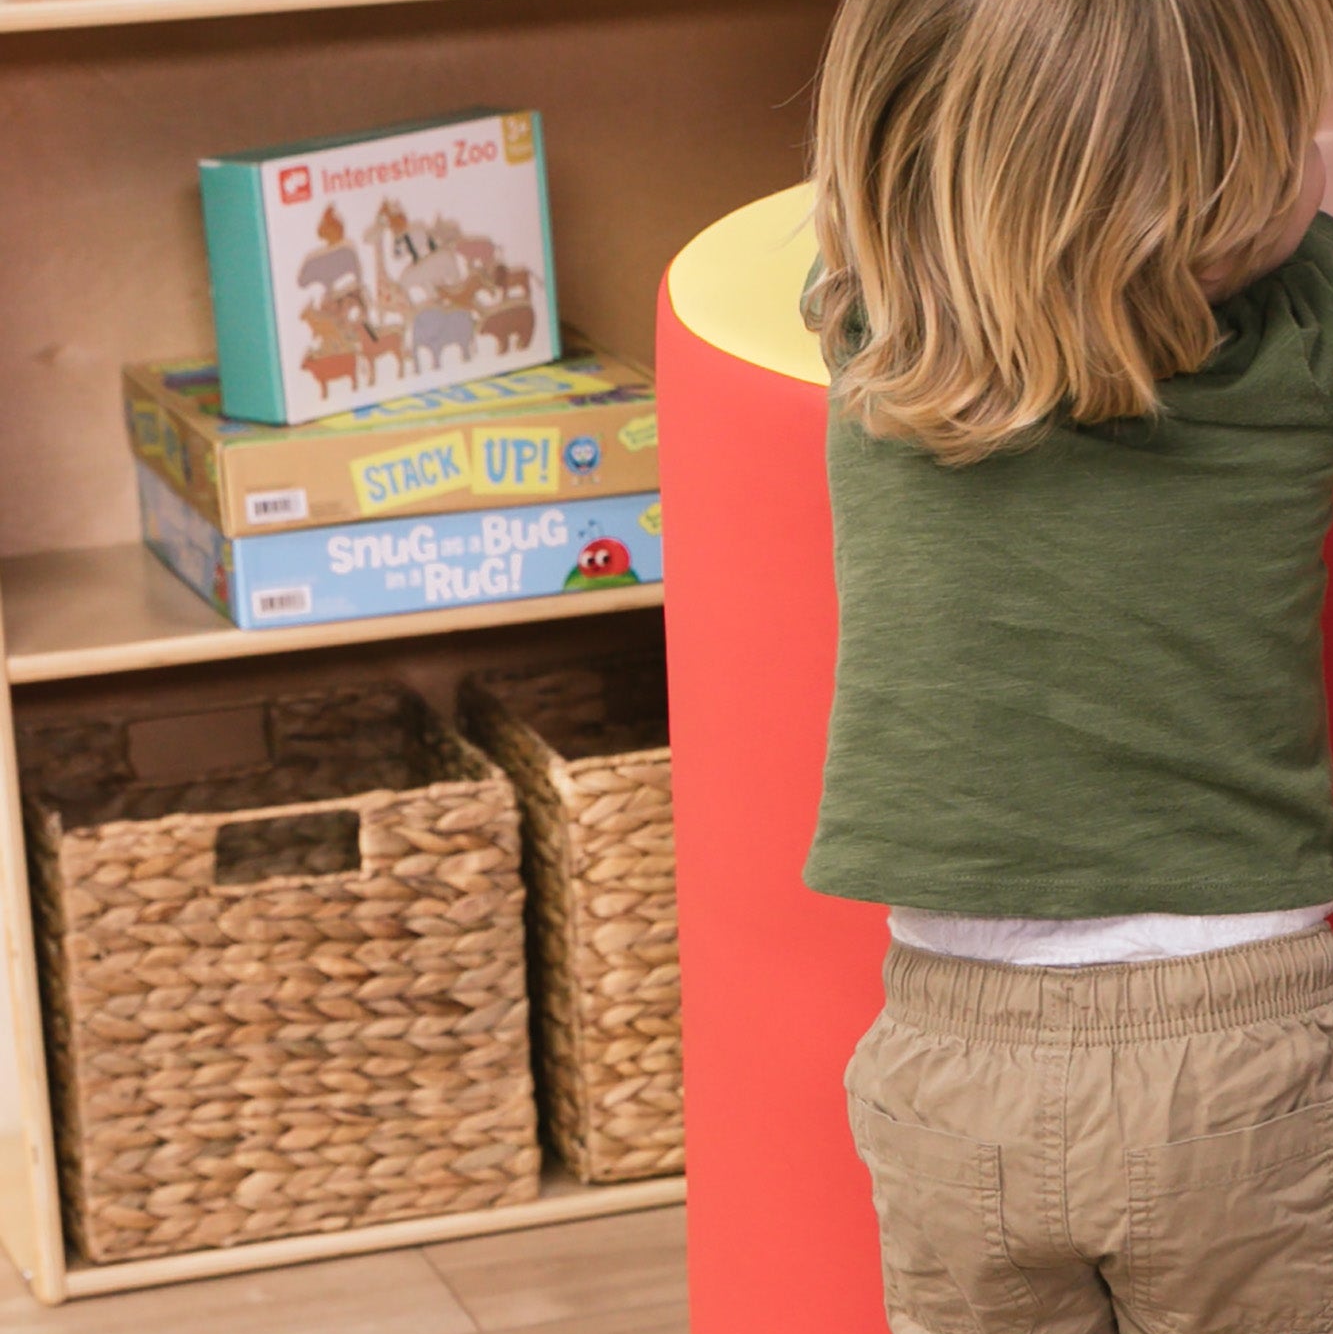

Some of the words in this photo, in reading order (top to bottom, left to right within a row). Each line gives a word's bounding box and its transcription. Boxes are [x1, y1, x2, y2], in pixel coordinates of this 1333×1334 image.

[322, 151, 447, 194] Interesting
[453, 140, 498, 169] Zoo
[363, 446, 461, 503] STACK
[484, 438, 550, 483] UP!
